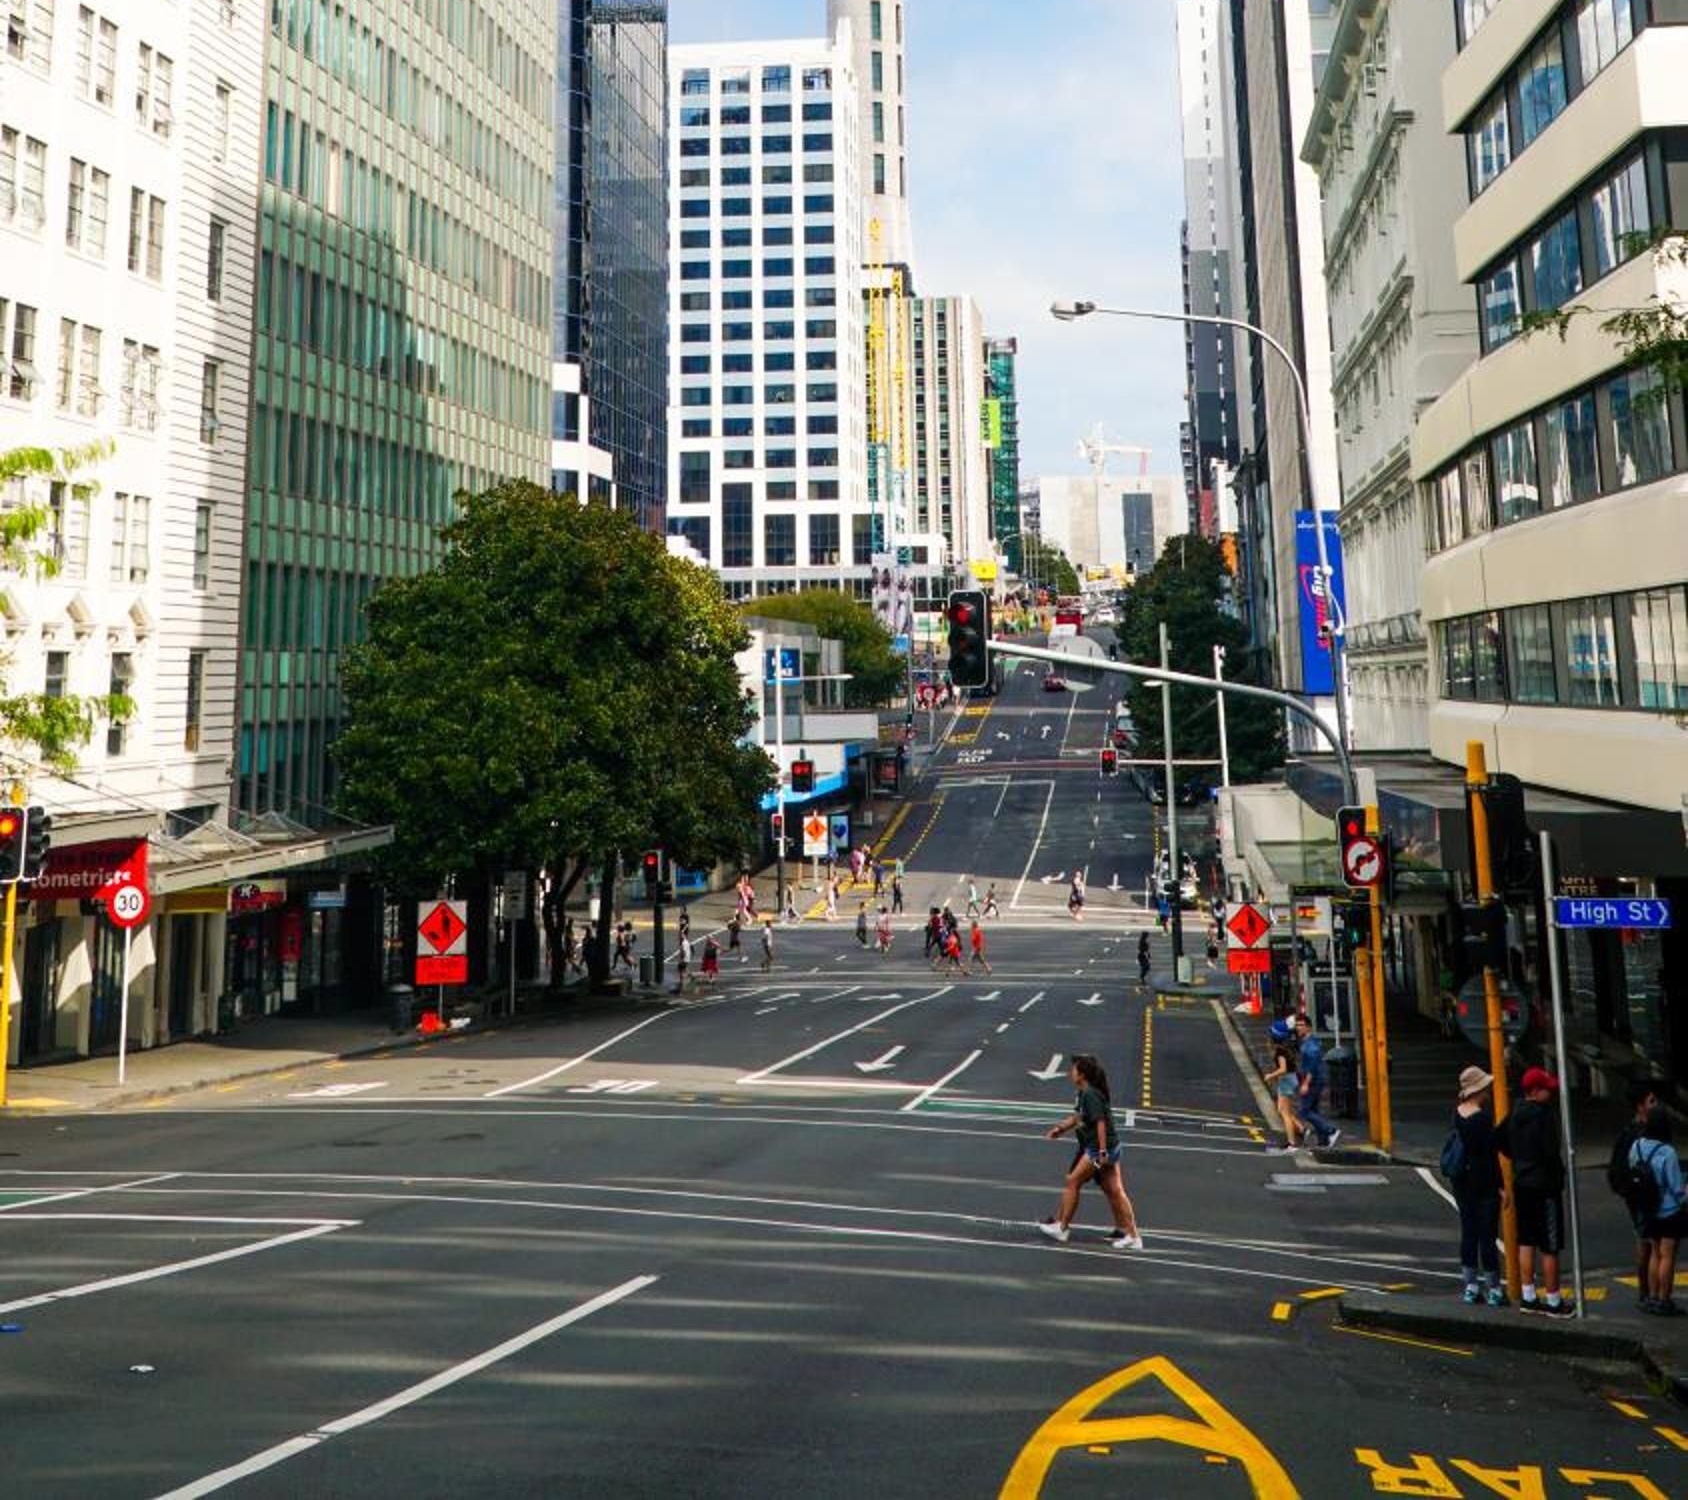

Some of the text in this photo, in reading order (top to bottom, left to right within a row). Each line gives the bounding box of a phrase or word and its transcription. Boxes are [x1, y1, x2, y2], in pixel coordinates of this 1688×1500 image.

[117, 894, 139, 912] 30
[1570, 901, 1651, 924] High St
